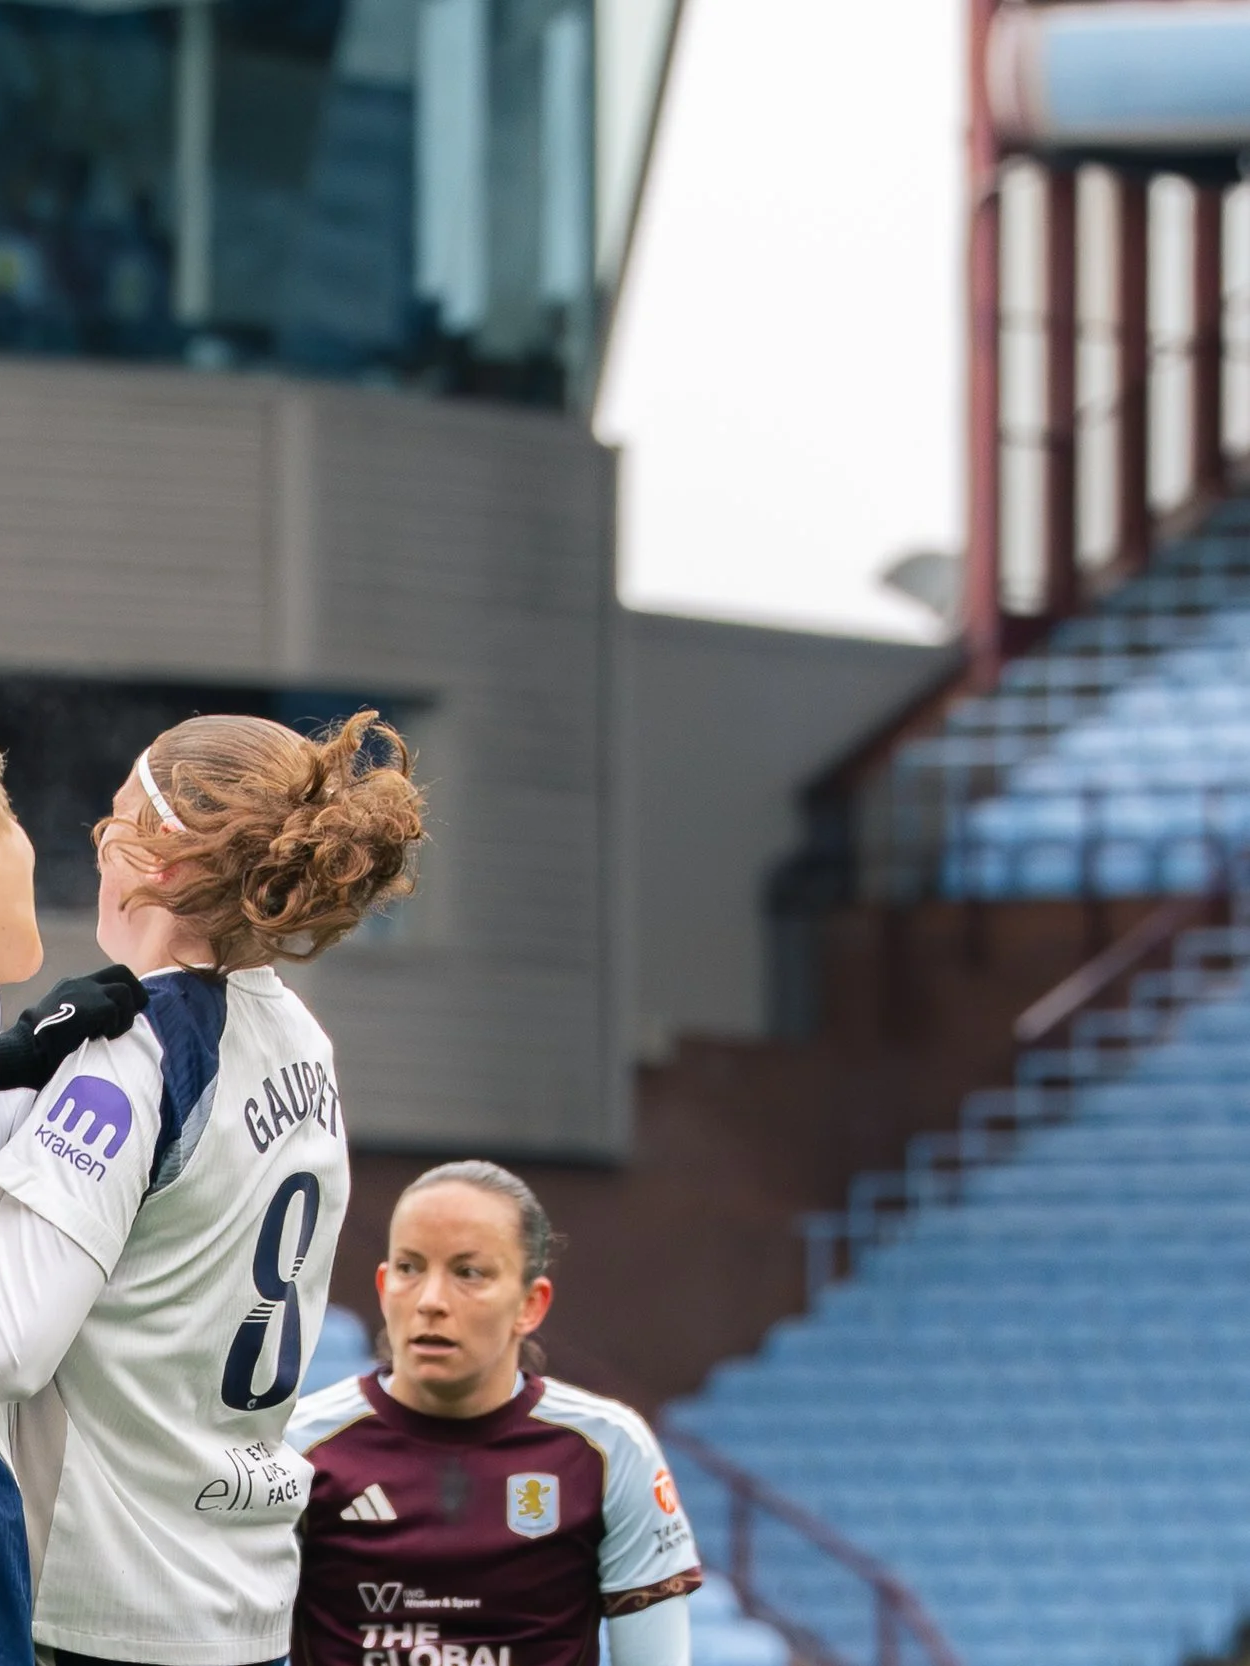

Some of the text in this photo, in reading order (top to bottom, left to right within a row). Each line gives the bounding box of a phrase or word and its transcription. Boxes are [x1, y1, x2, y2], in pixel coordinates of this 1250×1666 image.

[35, 1124, 107, 1183] kraken
[221, 1171, 321, 1412] 8
[266, 1479, 302, 1507] FACE.
[358, 1621, 440, 1648] THE
